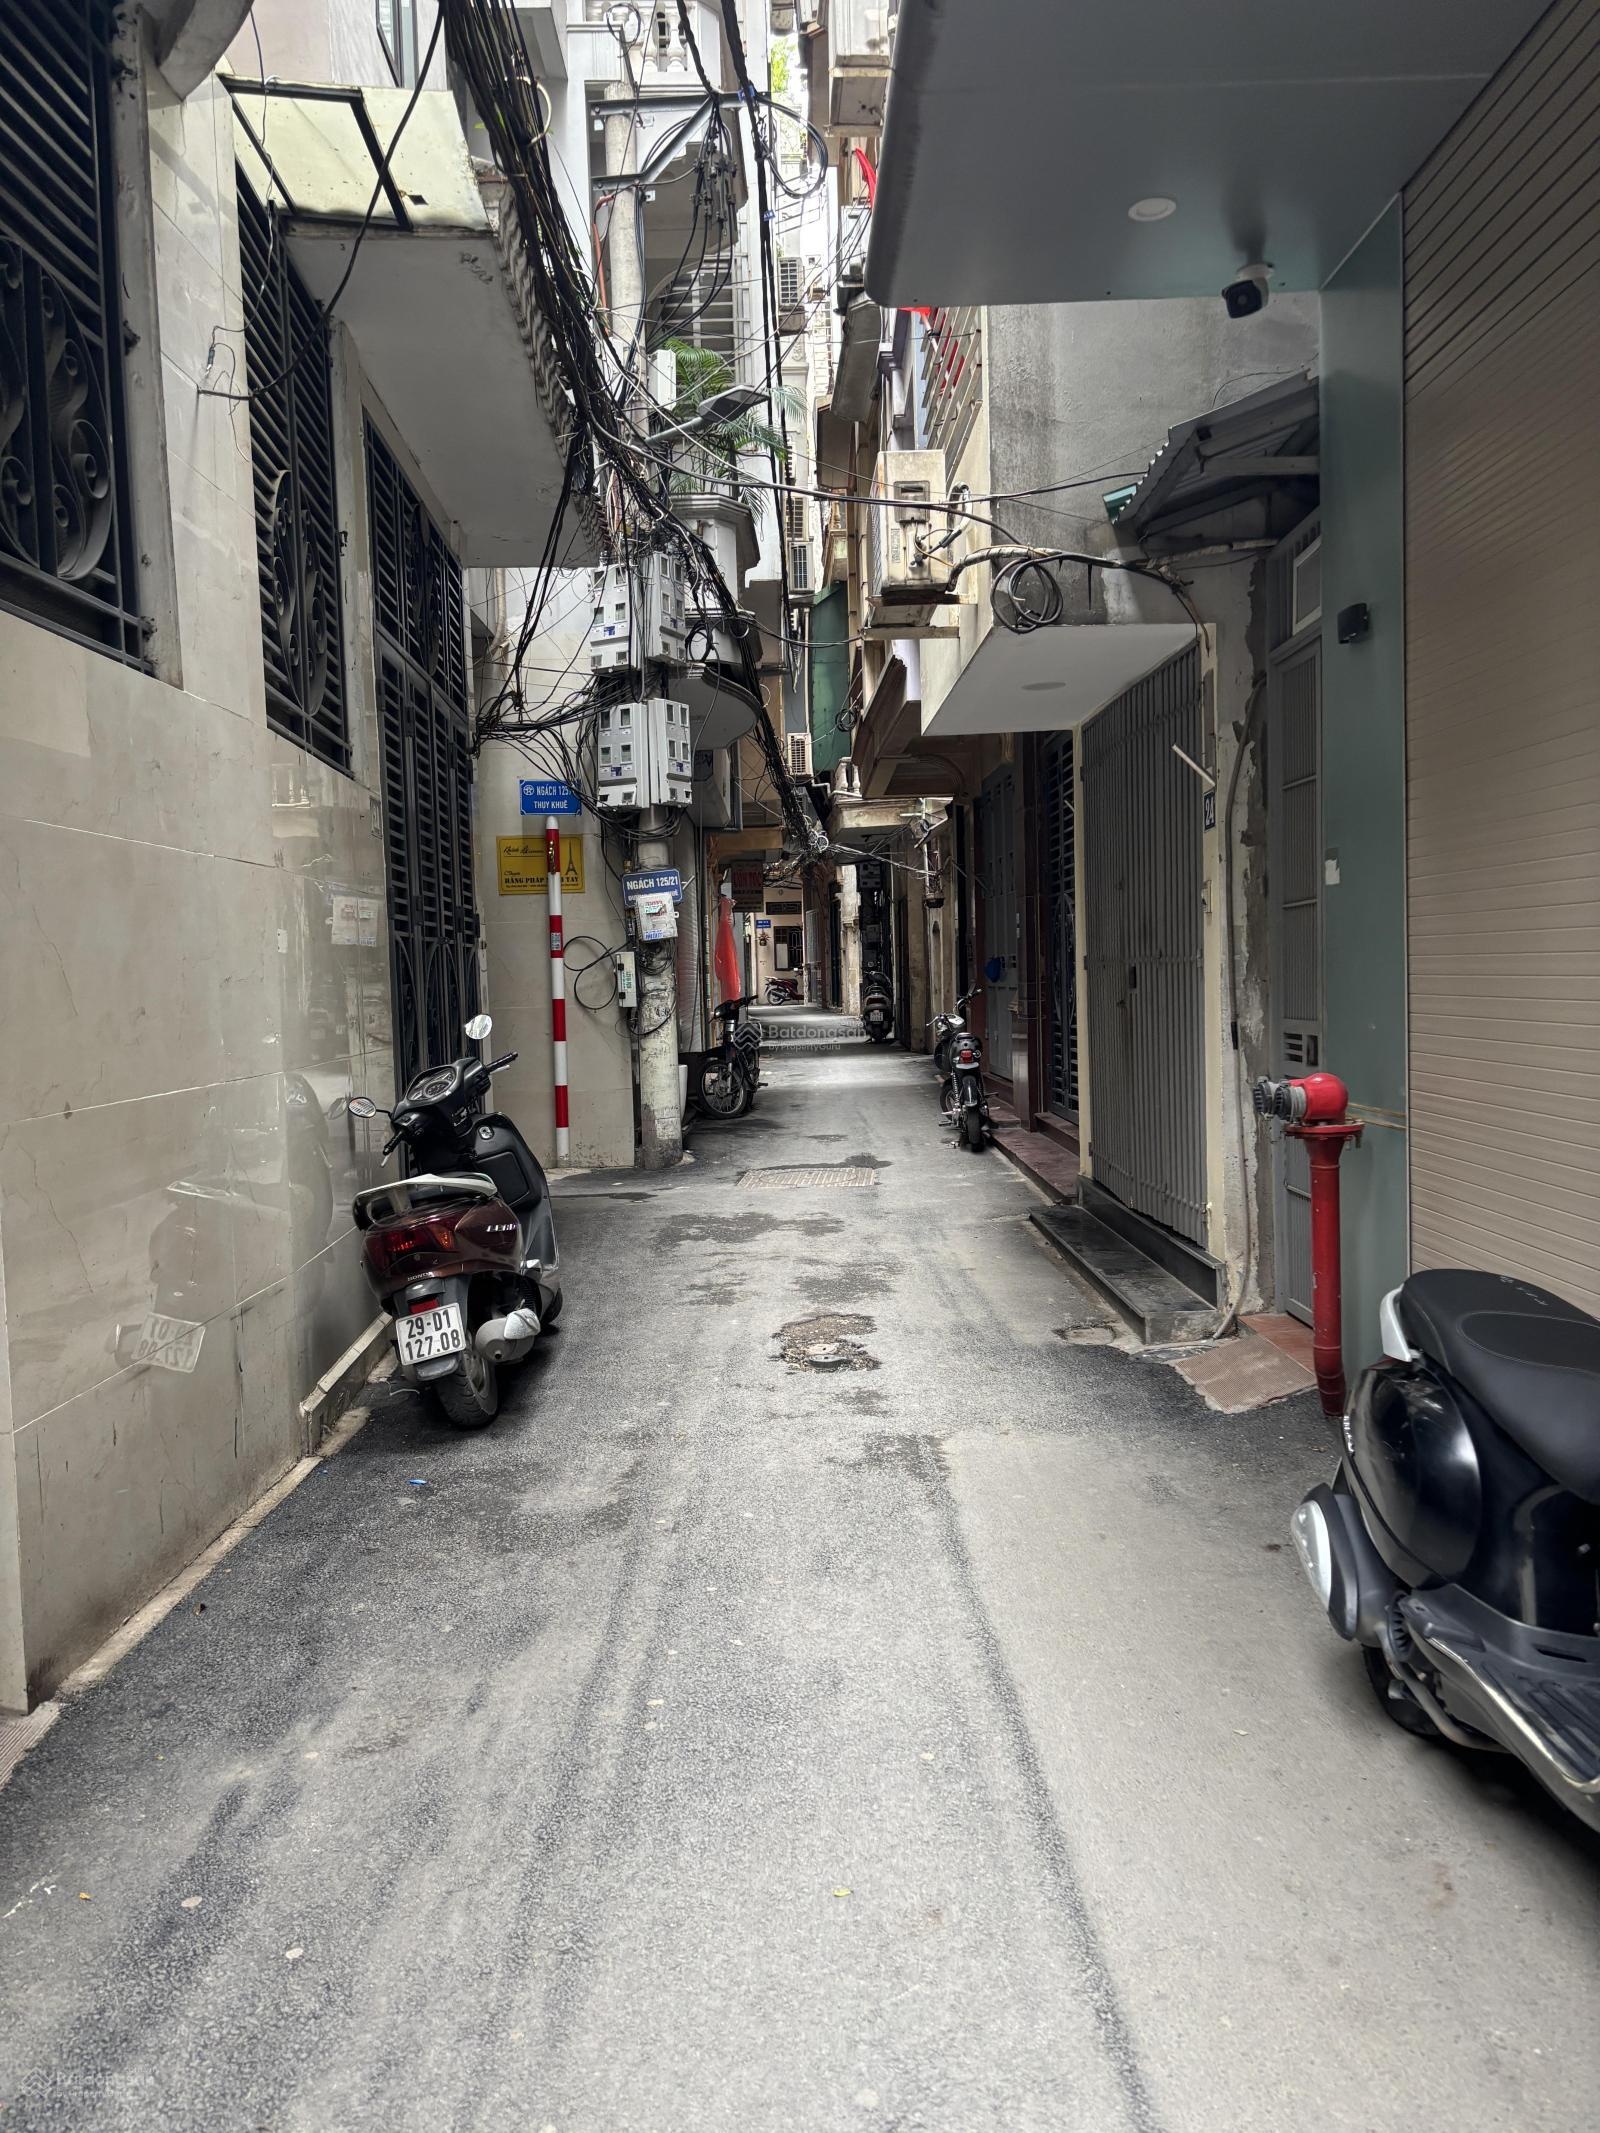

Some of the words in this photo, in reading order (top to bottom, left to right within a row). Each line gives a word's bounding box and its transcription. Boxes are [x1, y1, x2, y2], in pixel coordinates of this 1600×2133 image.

[536, 784, 557, 796] NGÁCH
[550, 799, 569, 809] KHUÊ
[1205, 797, 1214, 826] 24
[626, 877, 654, 890] NGÁCH
[655, 876, 679, 888] 125/21
[407, 1271, 435, 1282] HONDA
[406, 1309, 451, 1340] 29-D1
[405, 1329, 461, 1360] 127.08
